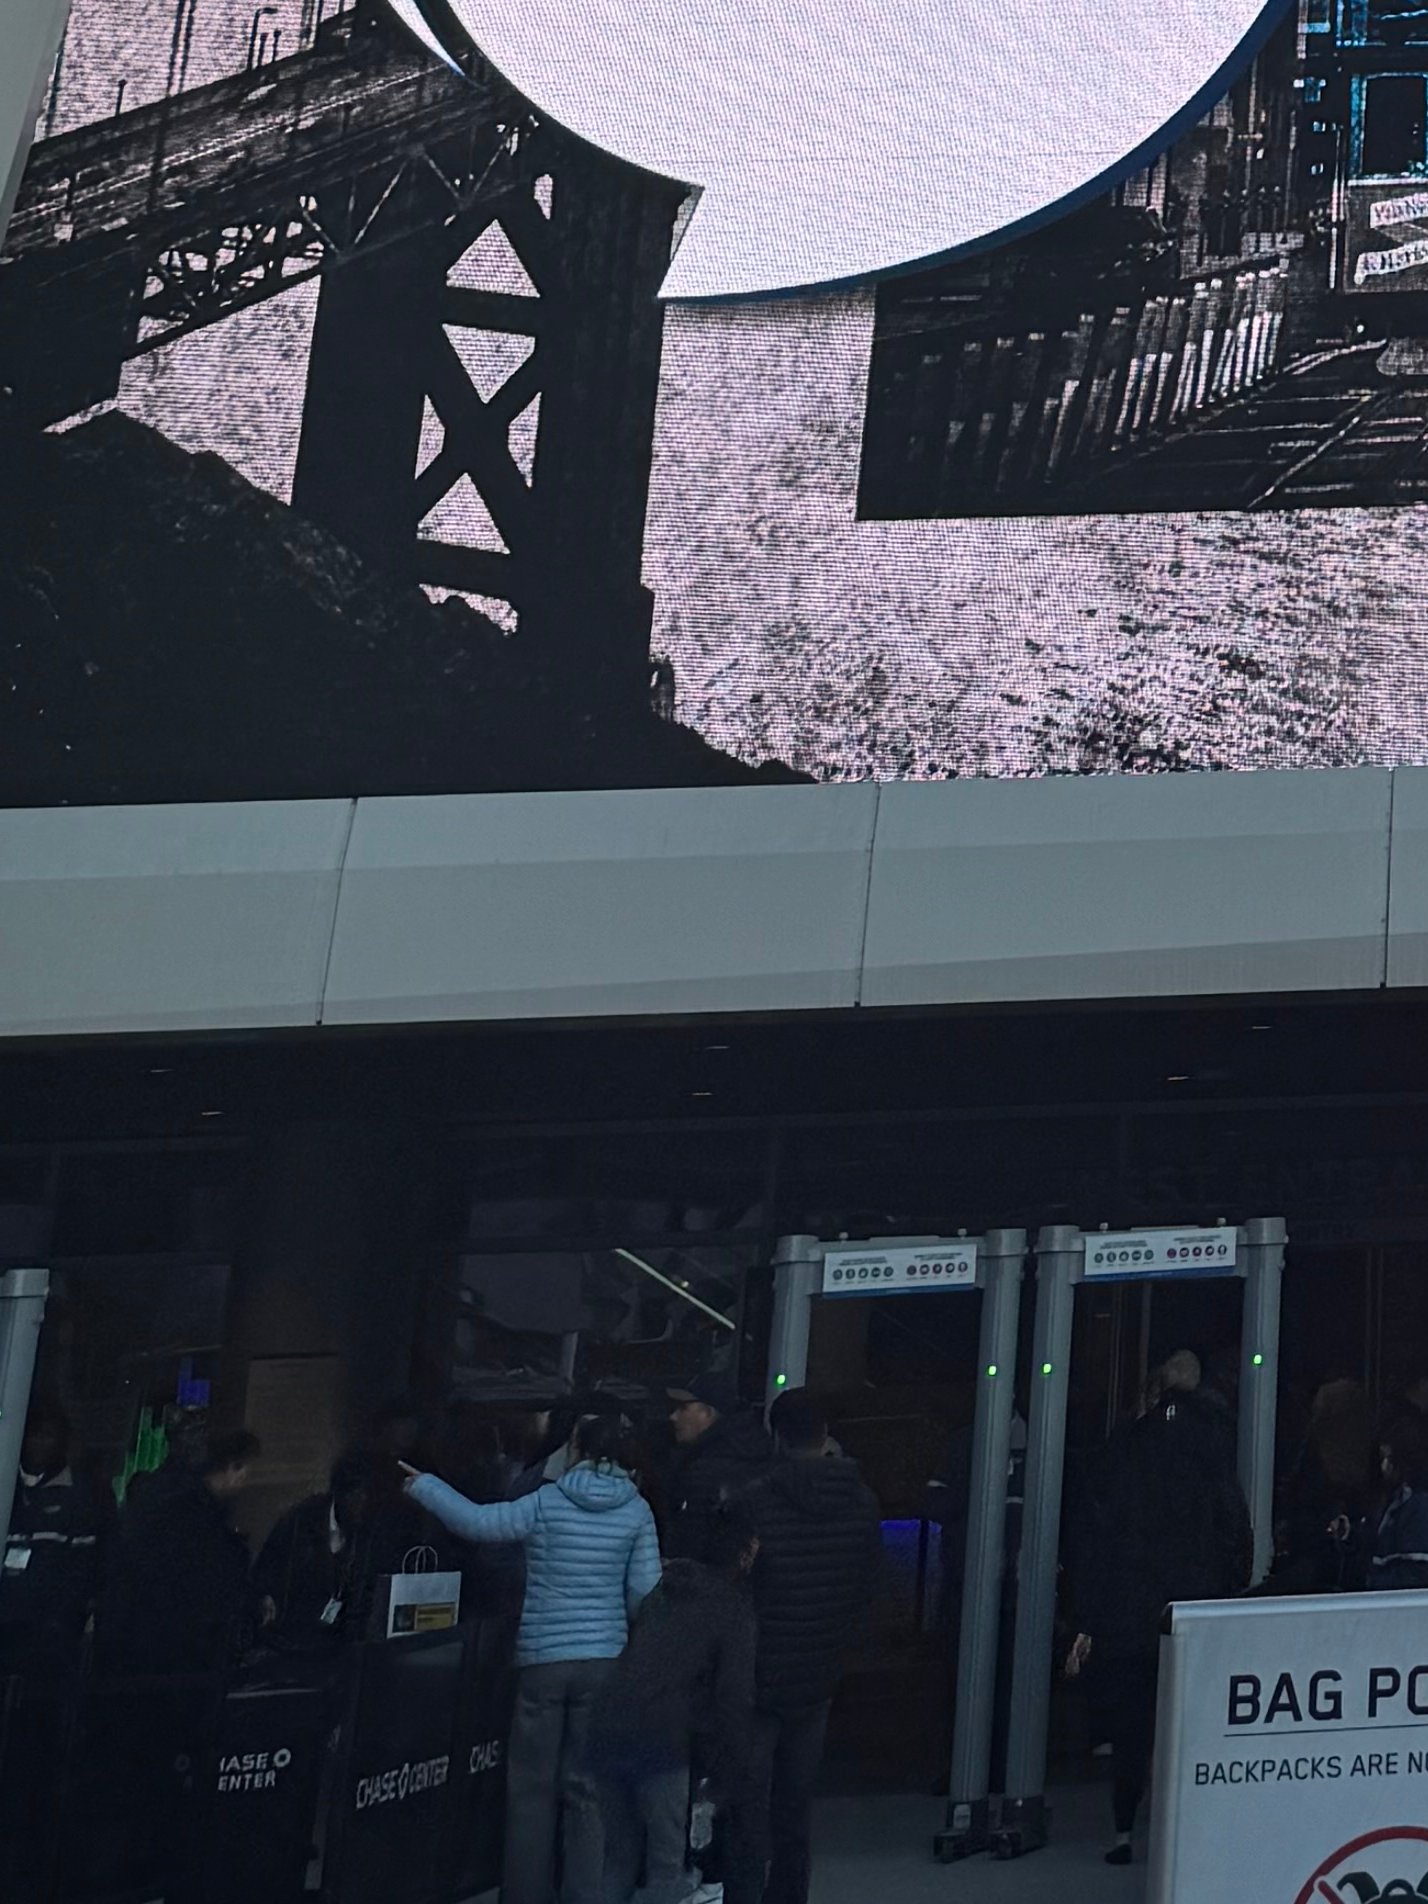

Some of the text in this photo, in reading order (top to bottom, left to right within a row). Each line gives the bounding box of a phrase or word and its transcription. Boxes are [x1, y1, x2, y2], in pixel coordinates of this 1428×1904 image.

[1227, 1669, 1343, 1725] BAG
[220, 1752, 269, 1772] ASE
[469, 1740, 499, 1775] CHAS
[1195, 1755, 1342, 1786] BACKPACKS
[1350, 1752, 1399, 1777] ARE
[217, 1769, 276, 1792] ENTER
